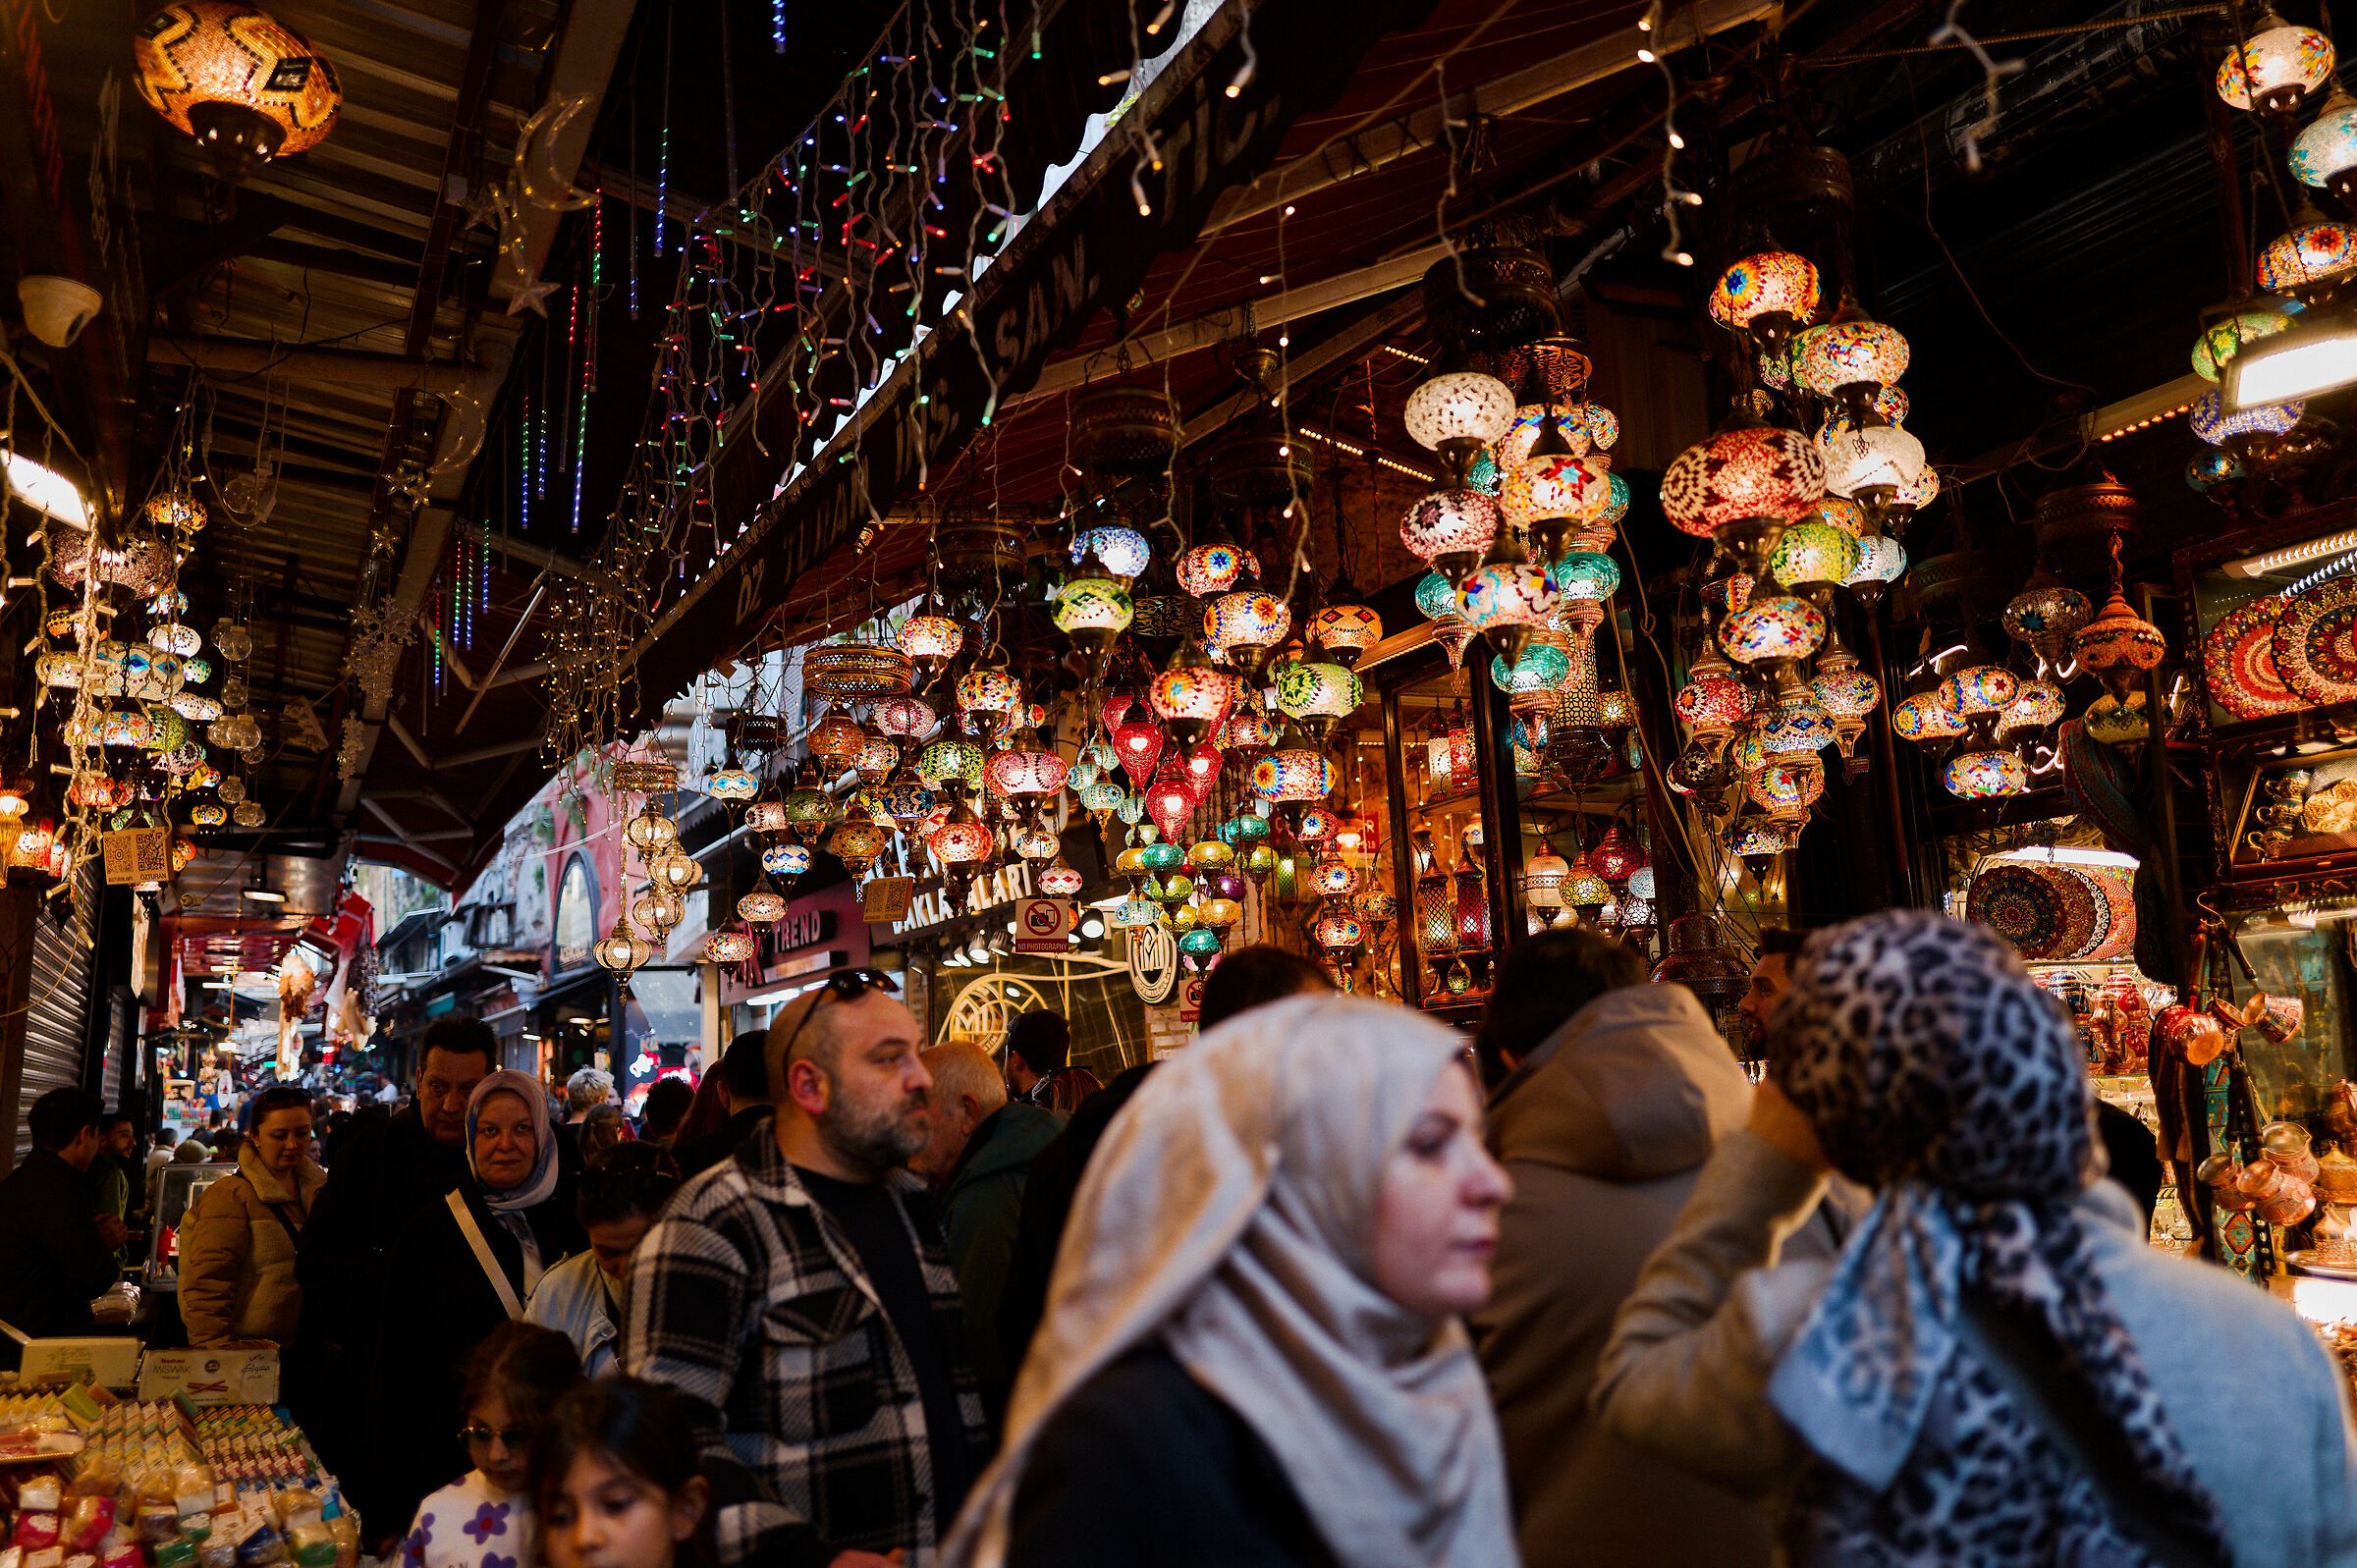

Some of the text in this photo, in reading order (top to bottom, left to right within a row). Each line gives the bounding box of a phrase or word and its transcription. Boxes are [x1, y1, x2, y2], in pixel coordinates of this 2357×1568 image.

[994, 230, 1101, 389] SAN.
[772, 910, 821, 953] TREND
[893, 860, 1033, 935] AKLAALARI
